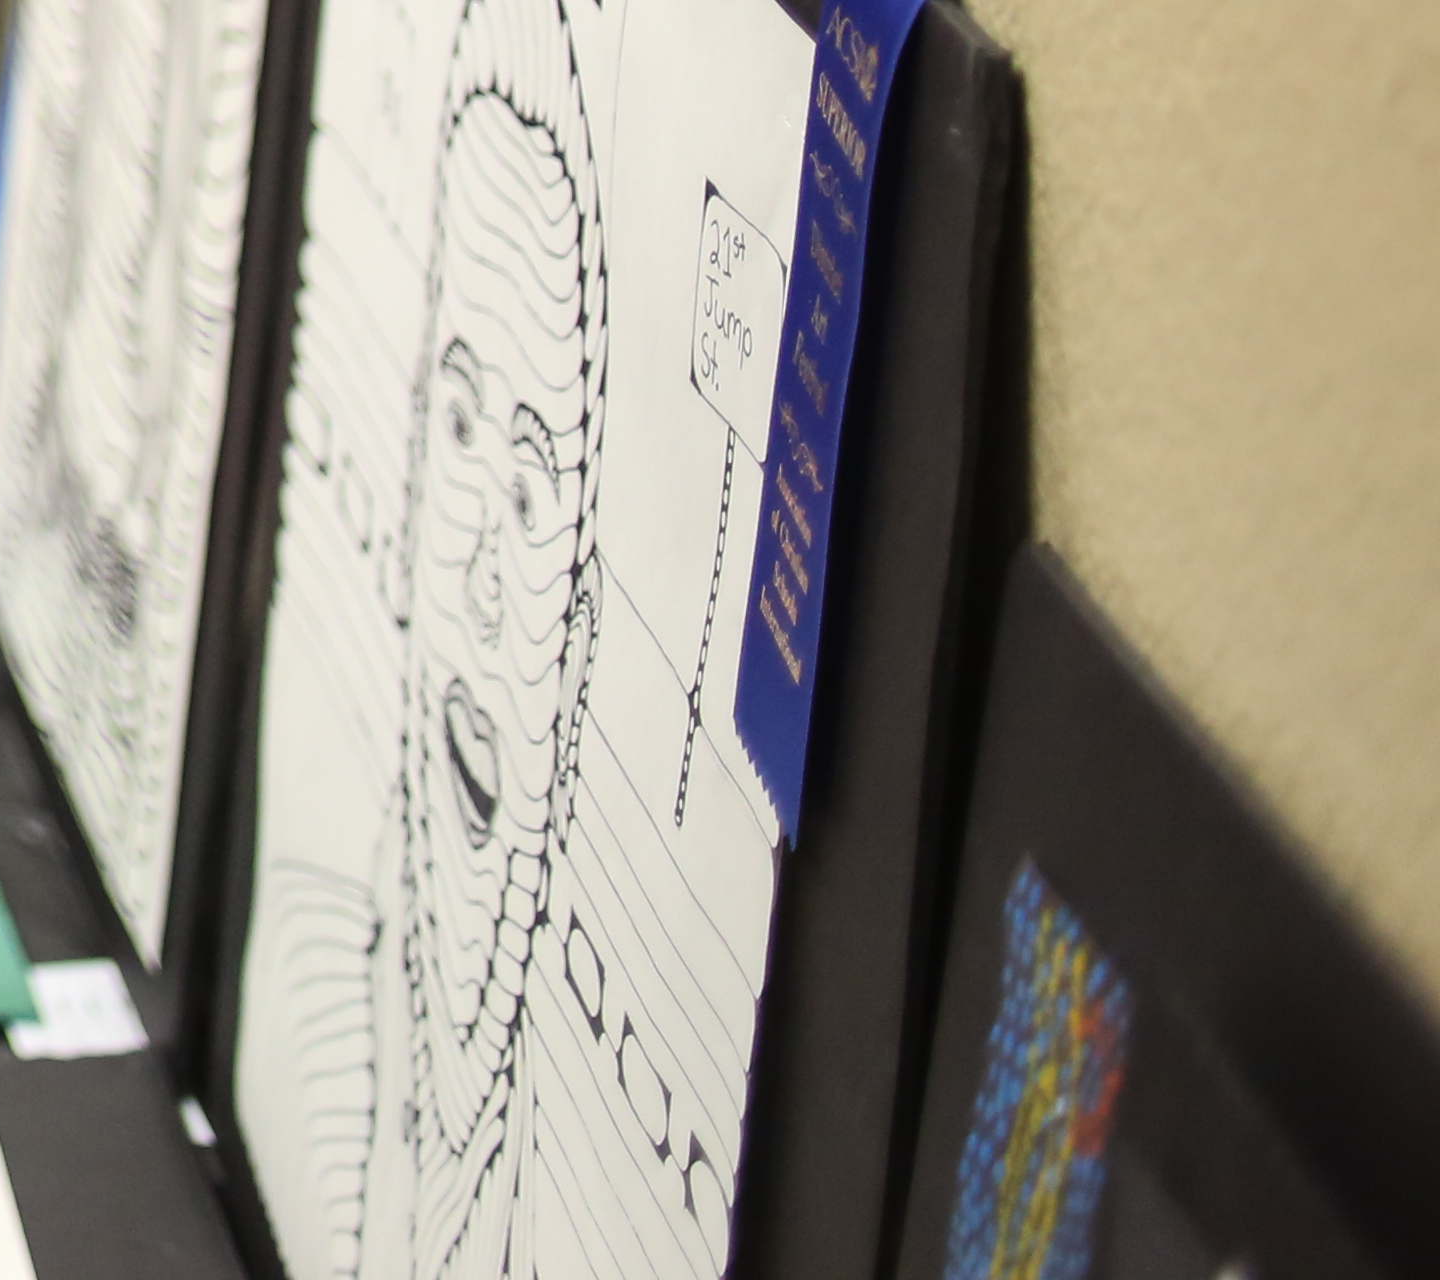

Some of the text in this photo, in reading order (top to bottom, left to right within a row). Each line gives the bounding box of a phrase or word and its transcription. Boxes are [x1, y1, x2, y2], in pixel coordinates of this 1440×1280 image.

[816, 71, 867, 180] SUPERIOR
[708, 219, 746, 278] 21st
[703, 275, 753, 370] Jump
[811, 294, 829, 345] Art
[700, 331, 721, 392] St.
[780, 520, 809, 595] Christian
[773, 560, 798, 627] Schools
[759, 584, 802, 687] International
